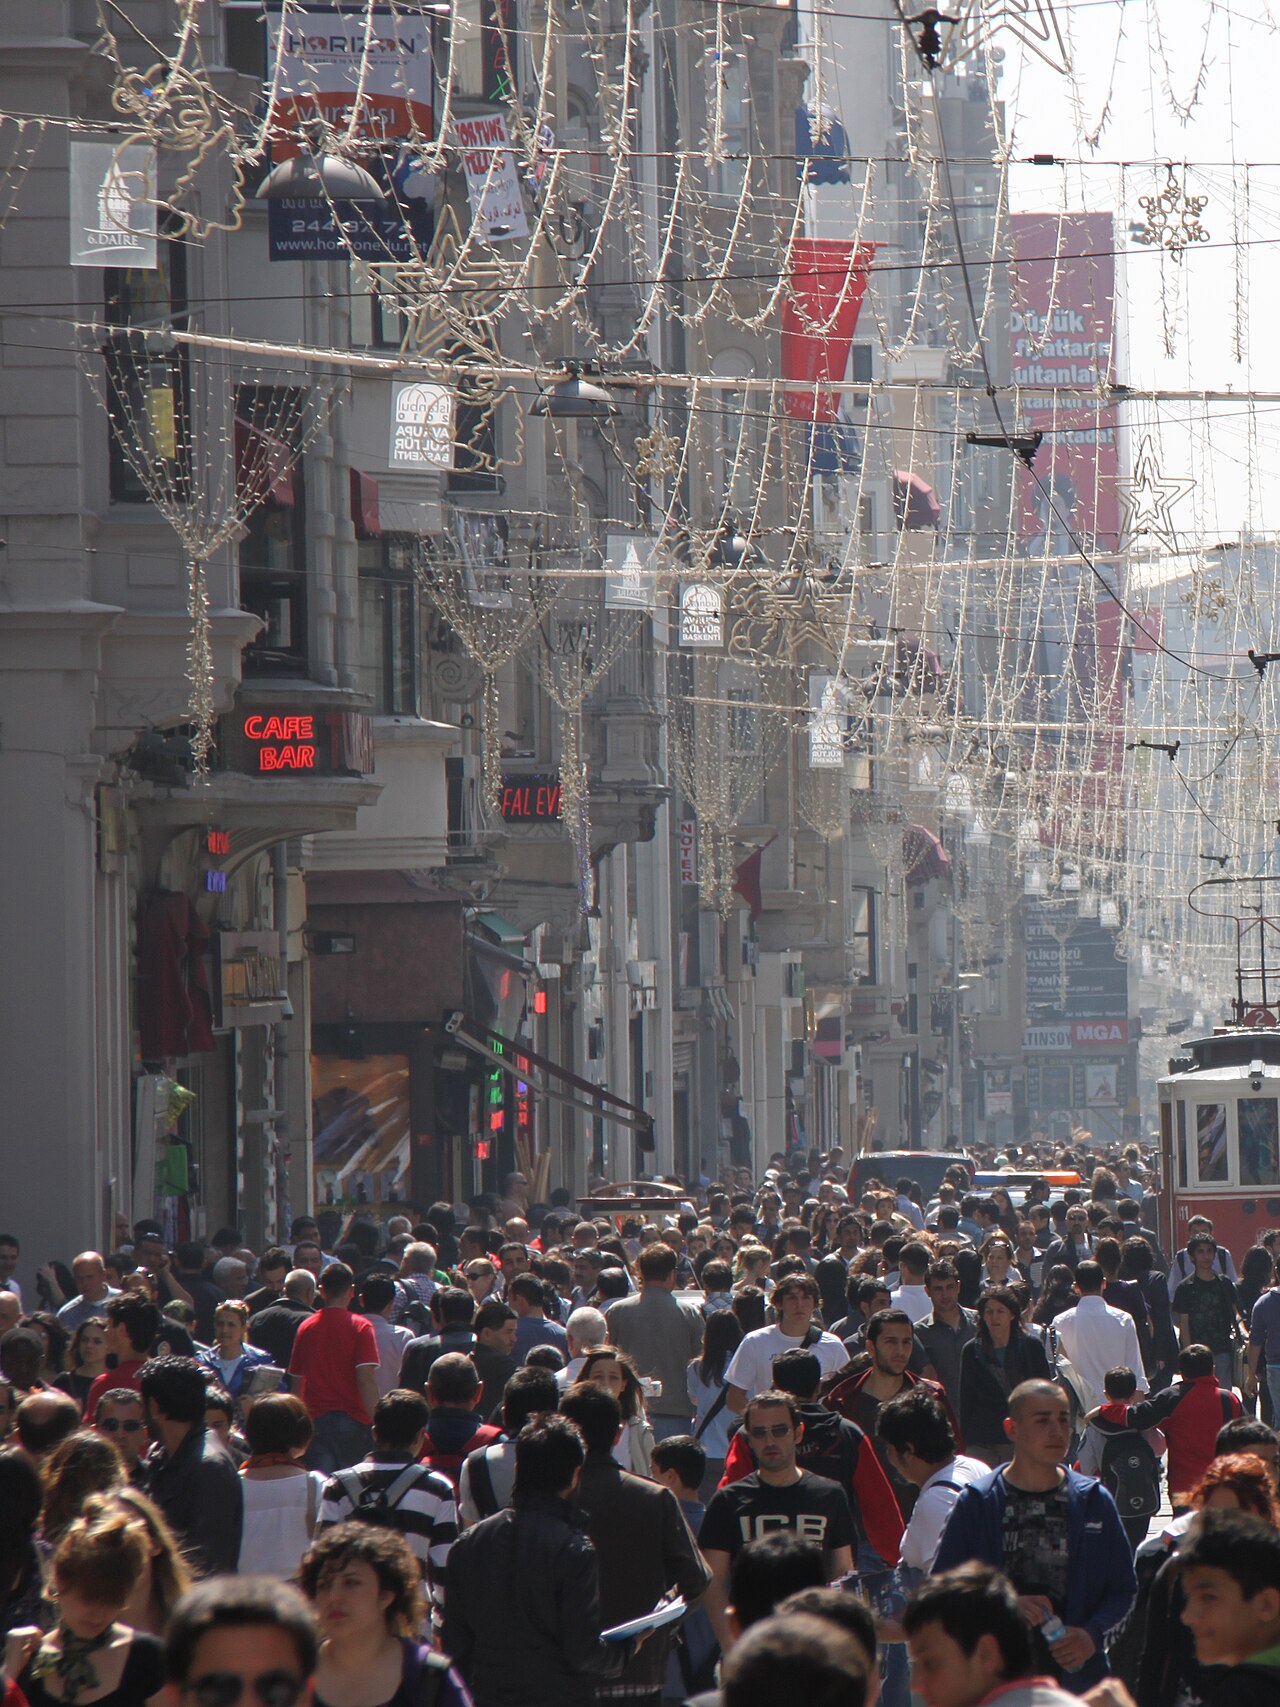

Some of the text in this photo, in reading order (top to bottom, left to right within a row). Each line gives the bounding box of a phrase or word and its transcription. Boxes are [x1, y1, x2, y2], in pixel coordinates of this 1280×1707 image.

[244, 715, 314, 739] CAFE
[259, 745, 315, 770] BAR
[501, 787, 531, 816] FAL
[680, 823, 693, 881] NOTER
[1255, 1010, 1265, 1026] 2
[1075, 1024, 1122, 1041] MGA
